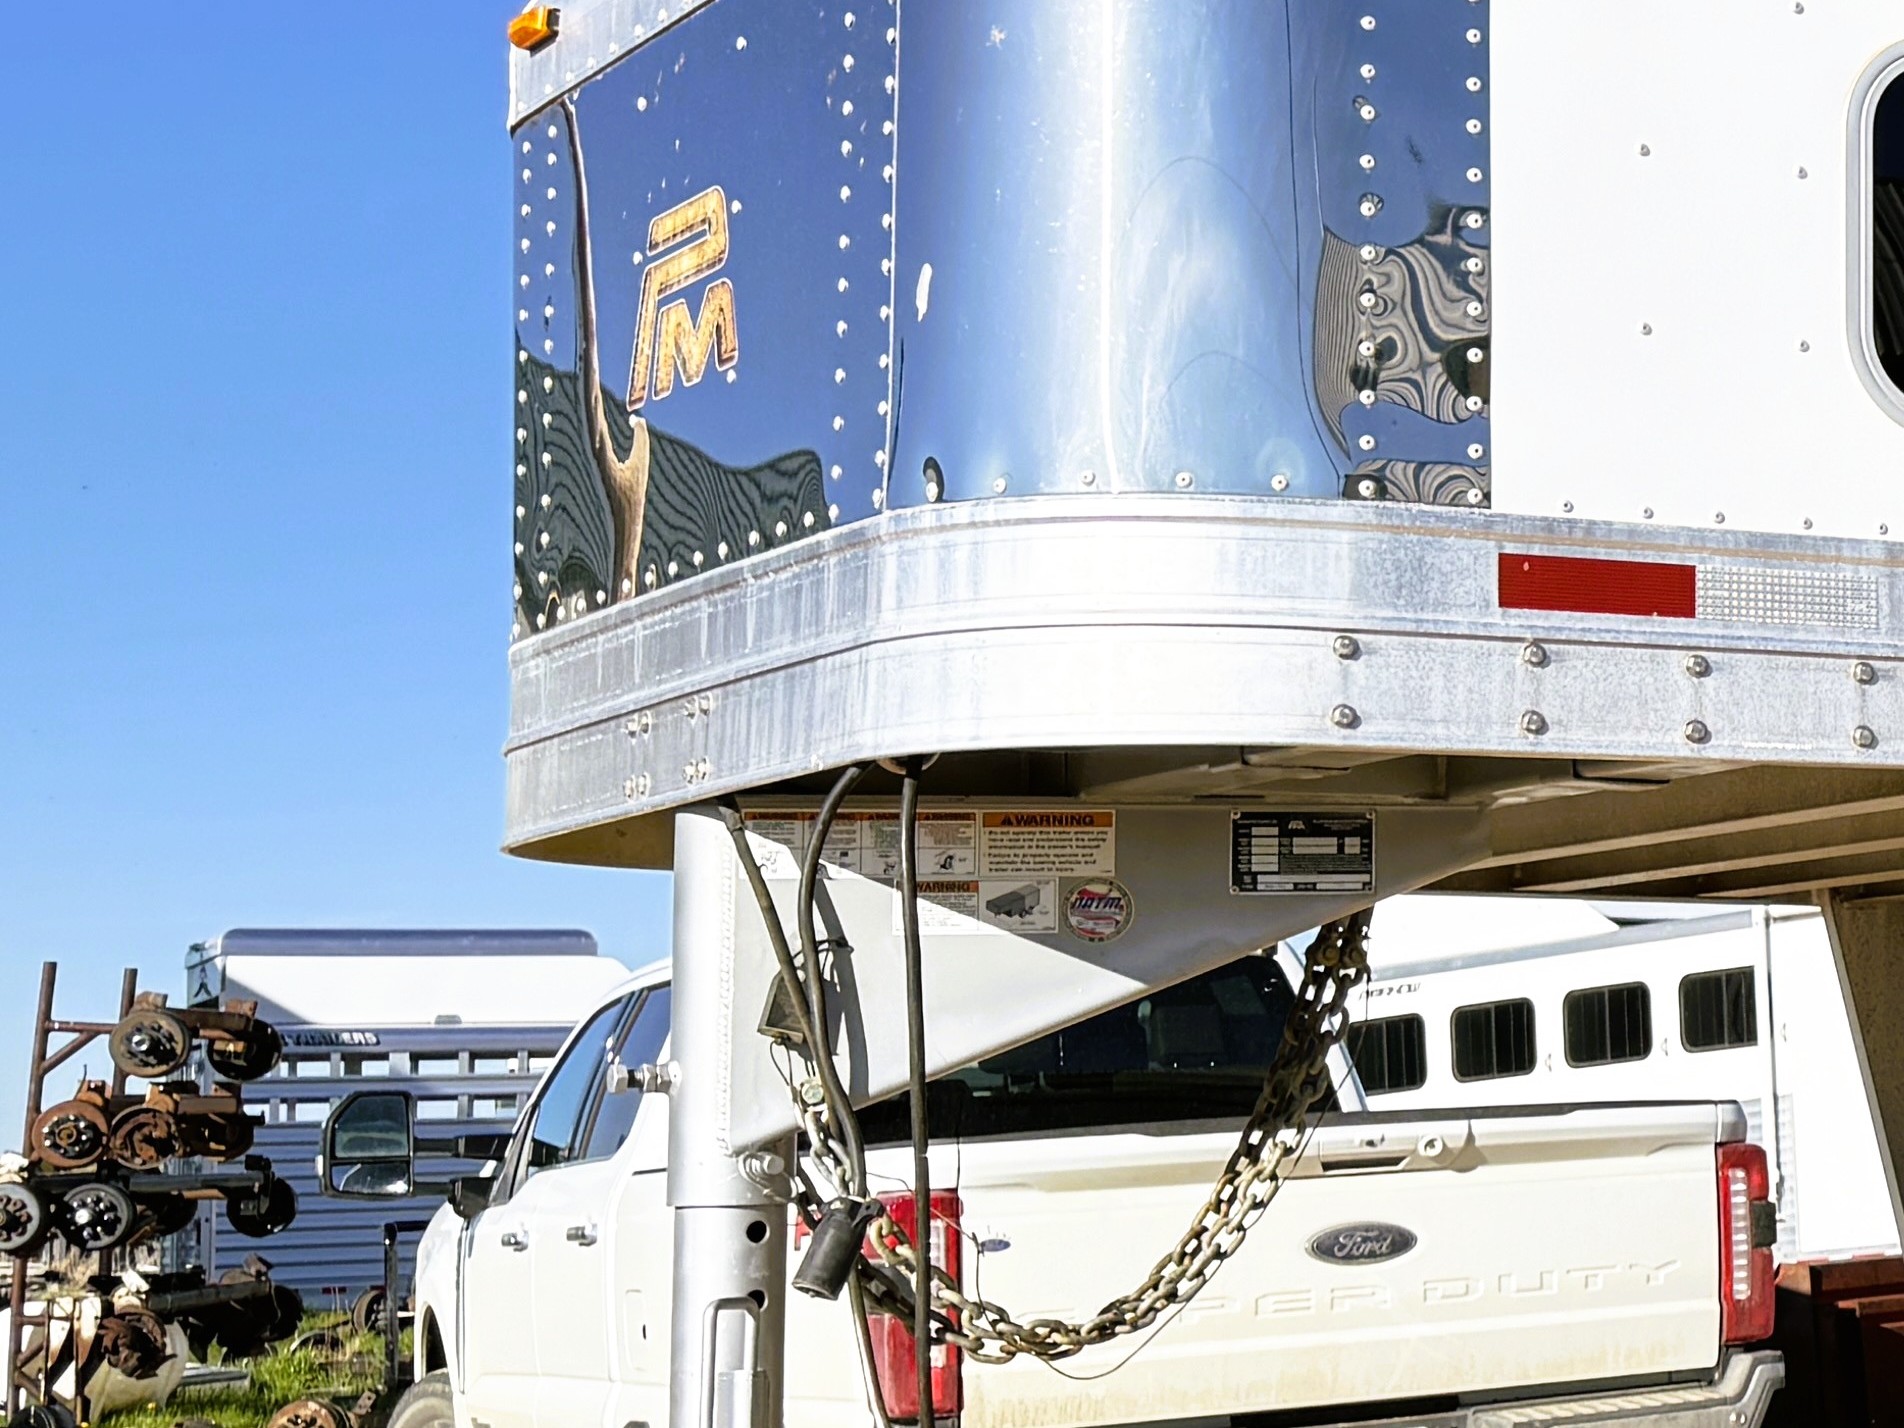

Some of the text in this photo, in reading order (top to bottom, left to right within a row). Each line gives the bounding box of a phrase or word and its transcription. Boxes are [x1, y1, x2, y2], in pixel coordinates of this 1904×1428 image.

[1015, 815, 1095, 827] WARNING
[1334, 1229, 1393, 1258] Ford
[1422, 1259, 1682, 1305] DUTY
